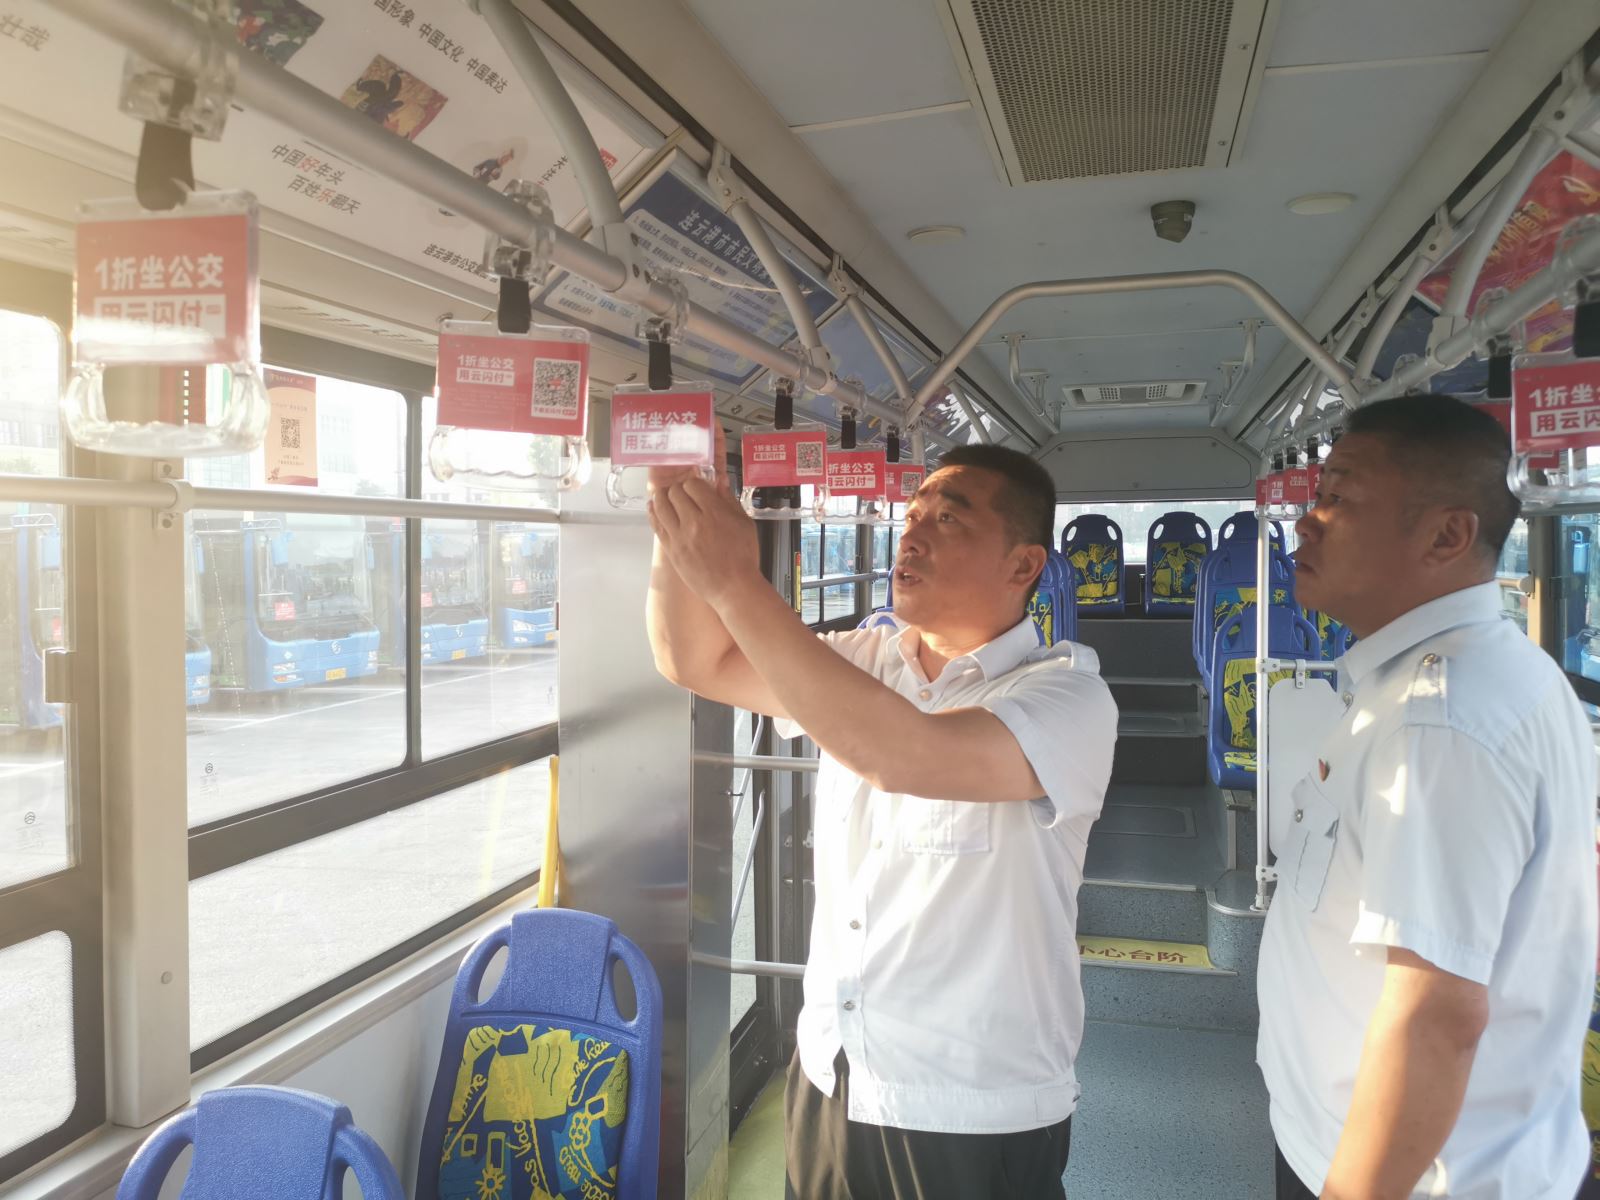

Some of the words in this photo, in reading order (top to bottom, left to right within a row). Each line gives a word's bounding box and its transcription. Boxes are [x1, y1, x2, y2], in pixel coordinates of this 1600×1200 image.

[419, 22, 464, 63] 中国文化
[466, 57, 508, 94] 中国表达
[271, 144, 345, 186] 中国好年头
[287, 174, 361, 214] 百姓乐翻天
[95, 253, 224, 290] 1折坐公交
[458, 355, 514, 370] 1折坐公交
[459, 370, 504, 384] 用云闪付
[1528, 383, 1600, 408] 1折坐
[622, 411, 697, 429] 1折坐公交
[625, 434, 684, 450] 用云闪
[1079, 945, 1188, 963] 小心台阶
